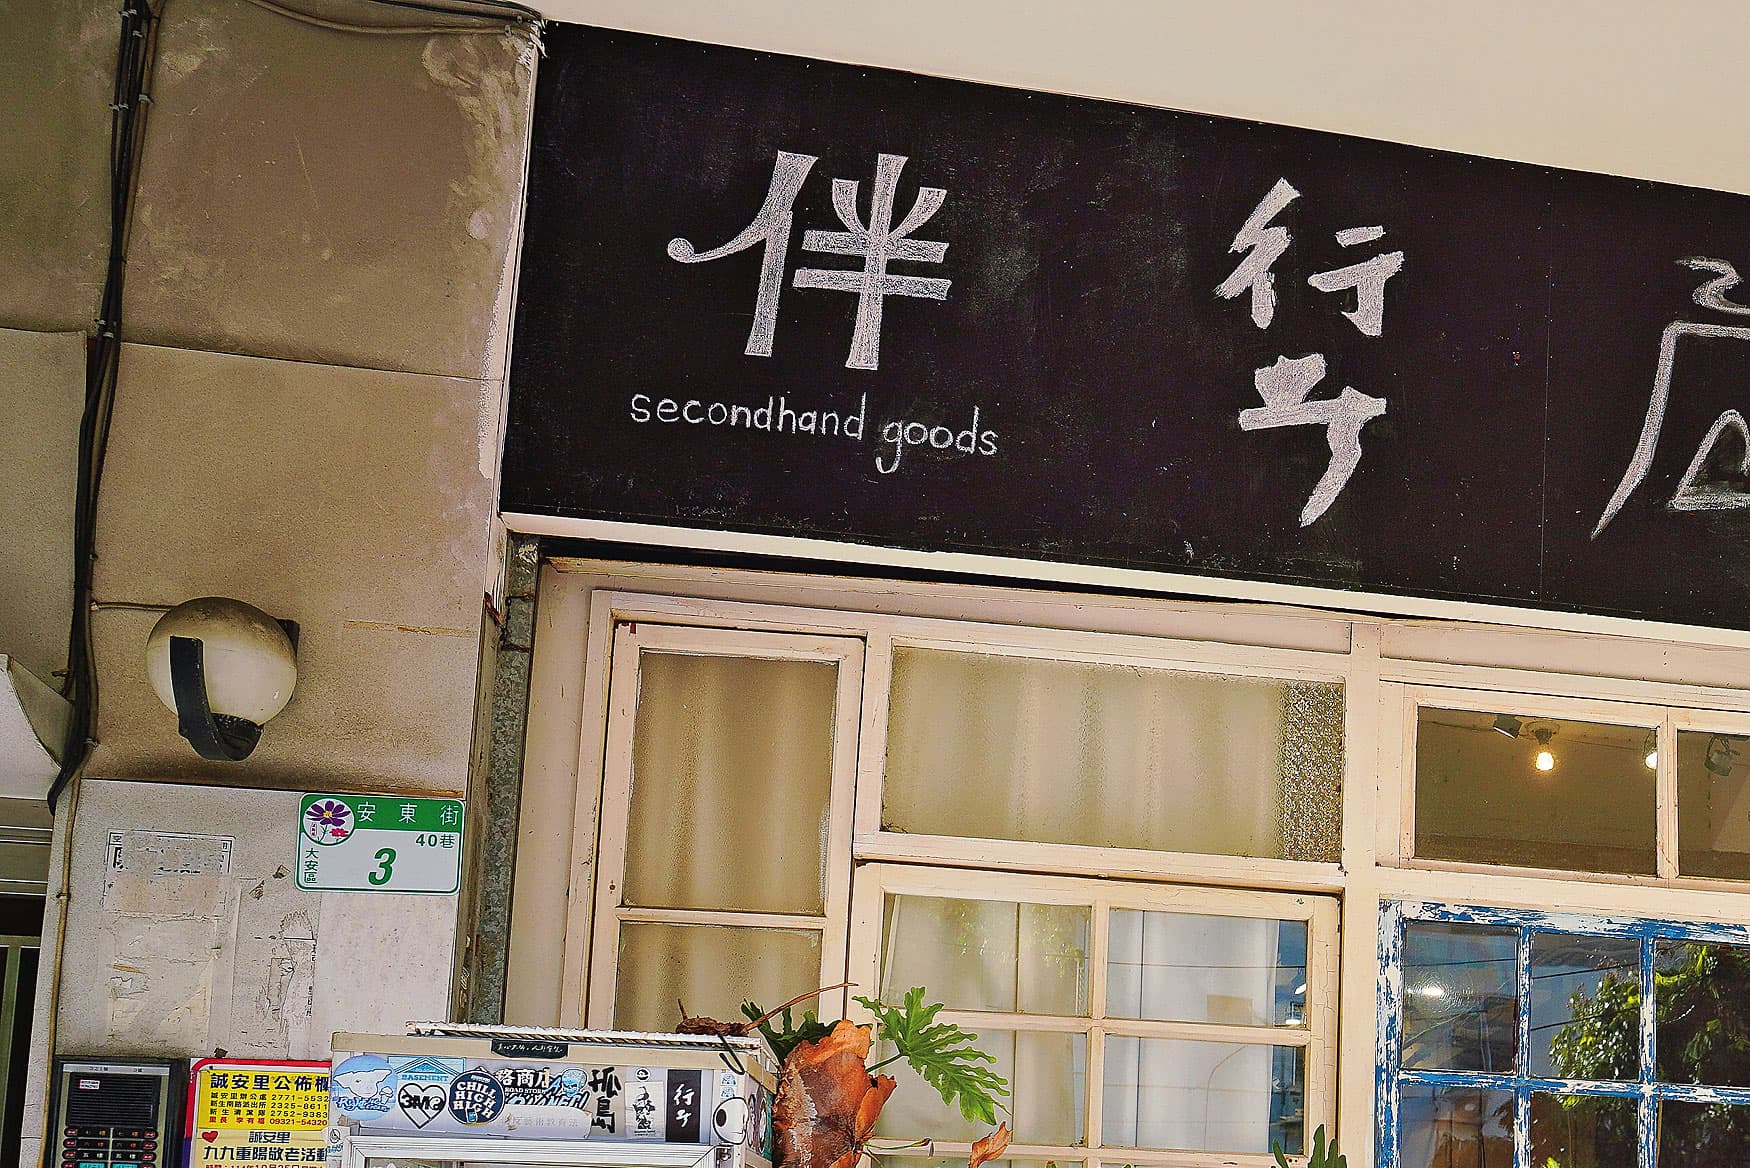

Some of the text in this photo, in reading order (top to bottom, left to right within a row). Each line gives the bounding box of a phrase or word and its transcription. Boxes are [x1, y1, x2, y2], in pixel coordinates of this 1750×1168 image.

[667, 150, 952, 371] 伴
[630, 392, 998, 474] secondhand goods
[357, 801, 459, 826] 安東街
[415, 833, 456, 849] 40巷
[304, 848, 319, 884] 大安區
[368, 847, 397, 886] 3
[456, 1081, 496, 1099] CHILL
[271, 1102, 328, 1110] 2325-8611
[455, 1091, 497, 1108] HIGH
[269, 1118, 328, 1126] 09321-54320
[270, 1110, 328, 1118] 2752-9383
[248, 1131, 291, 1144] 誠安里
[203, 1146, 327, 1162] 九九重陽敬老活動
